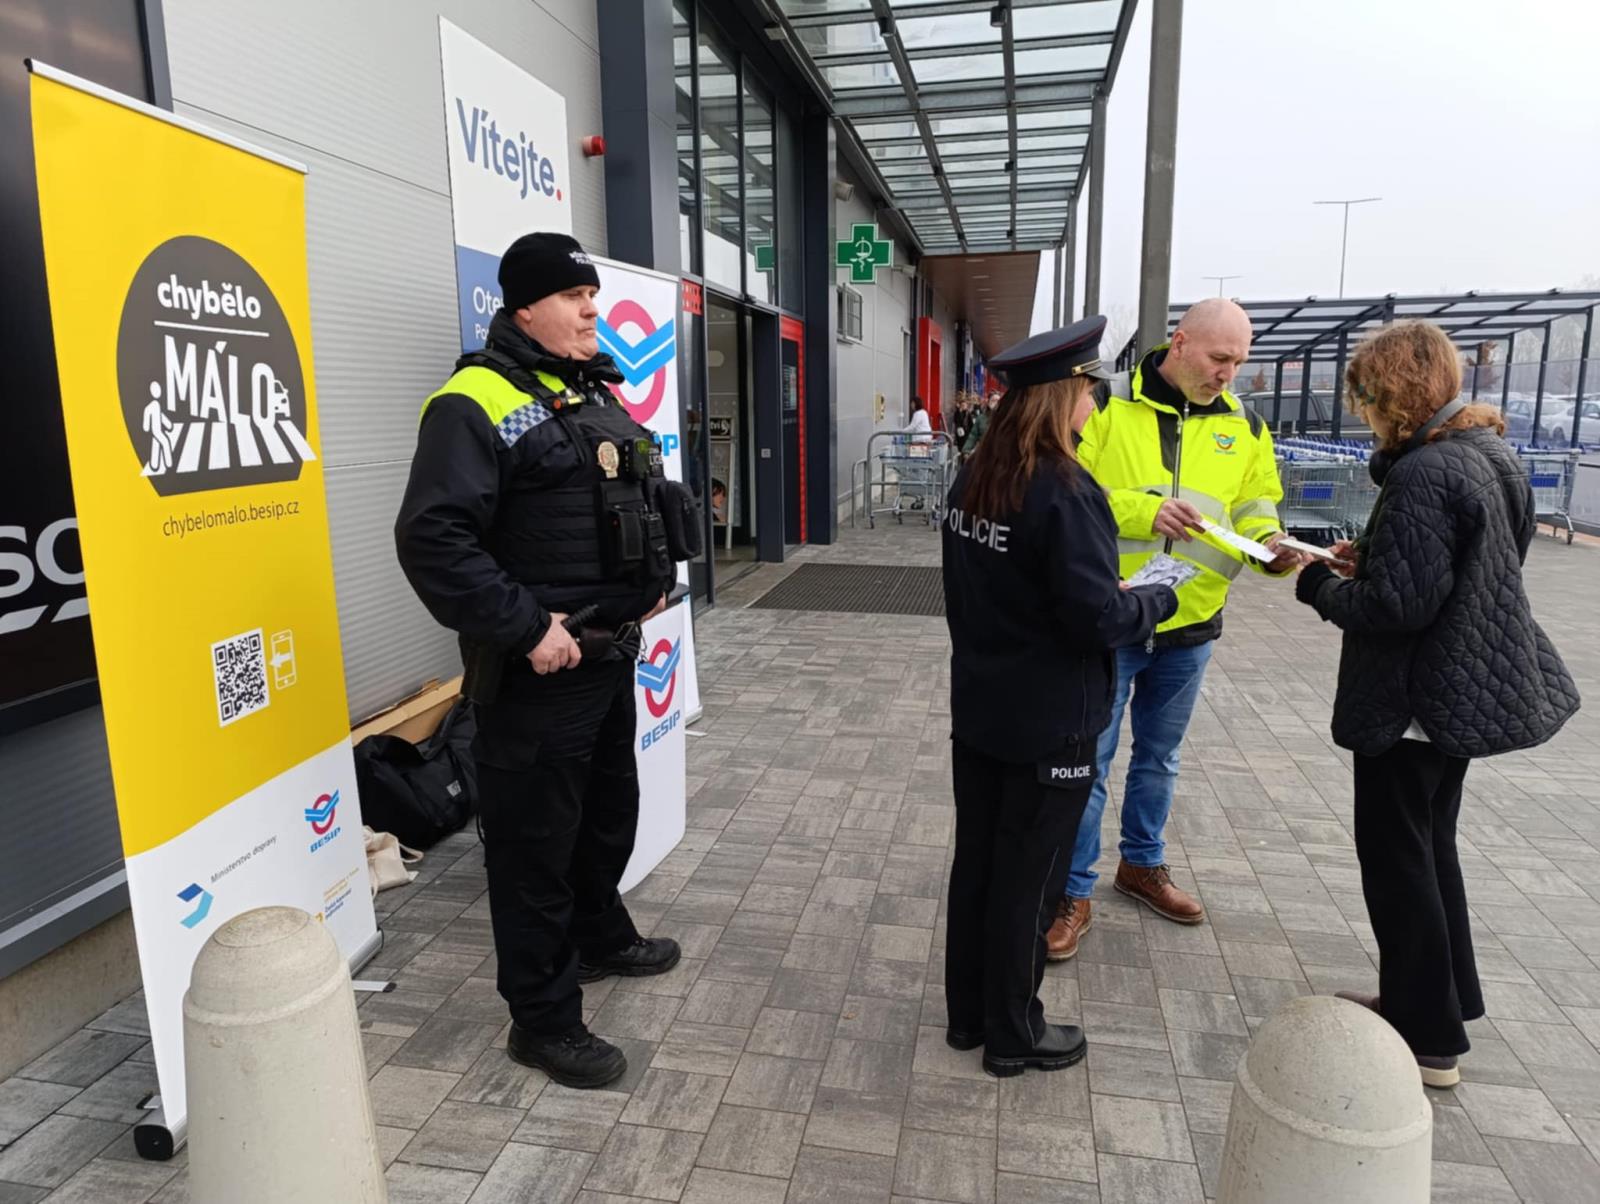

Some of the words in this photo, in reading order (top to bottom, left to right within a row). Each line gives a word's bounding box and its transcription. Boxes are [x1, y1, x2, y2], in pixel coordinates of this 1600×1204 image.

[455, 97, 562, 201] Vítejte.
[157, 274, 261, 320] chybělo
[164, 334, 276, 429] MÁLO
[163, 500, 299, 539] chybelomalo.besip.cz
[641, 709, 681, 751] BESIP
[1051, 765, 1090, 779] POLICIE
[310, 827, 341, 853] BESIP
